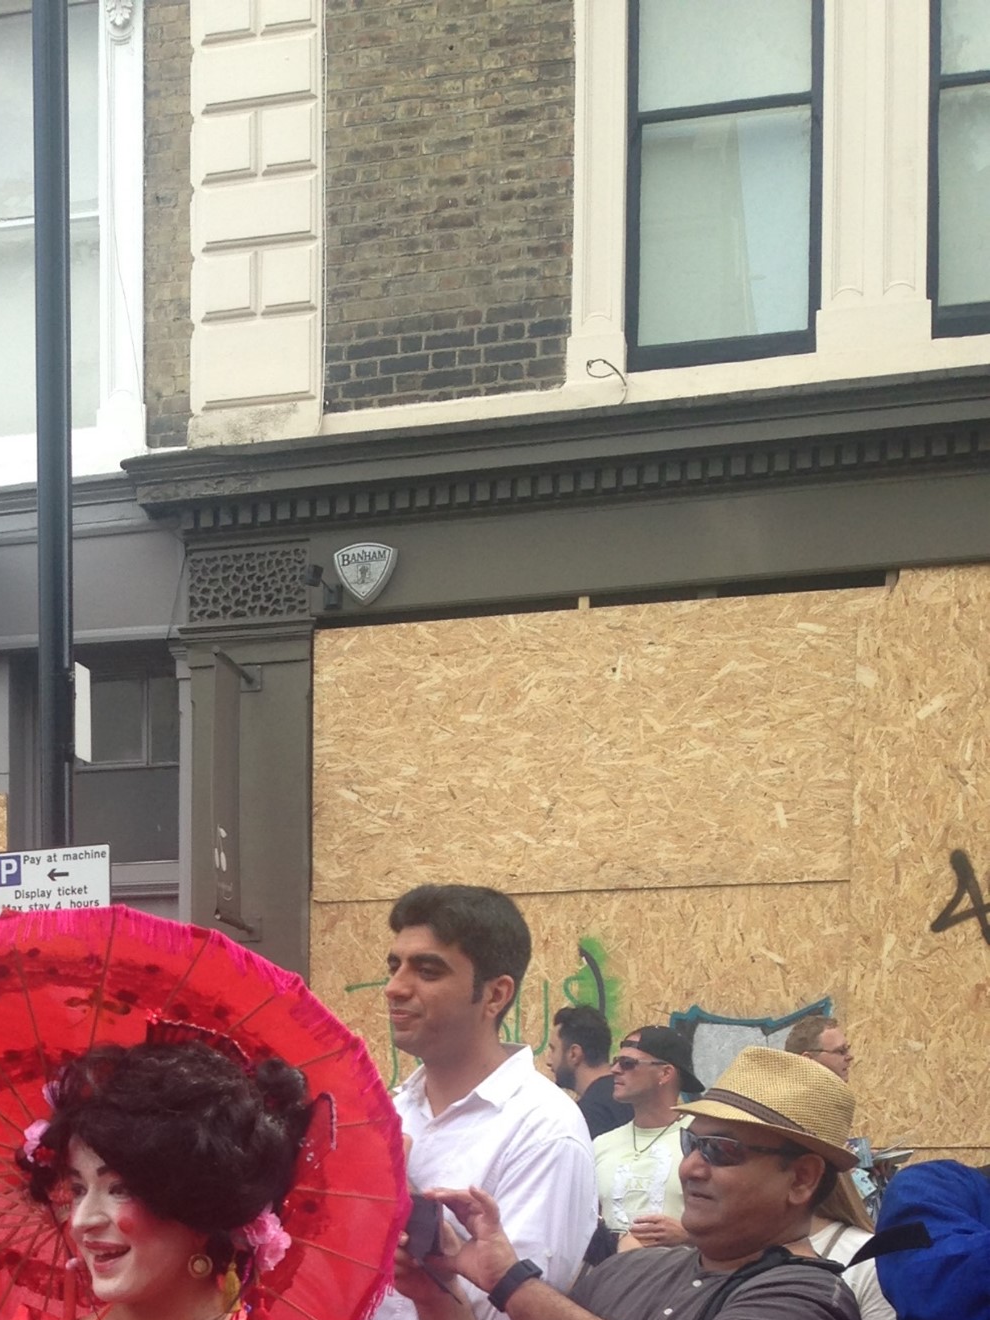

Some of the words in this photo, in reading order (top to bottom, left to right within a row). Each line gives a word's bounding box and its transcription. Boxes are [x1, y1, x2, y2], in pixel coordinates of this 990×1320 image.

[341, 549, 387, 567] BANHAM
[23, 855, 42, 866] Pay
[47, 852, 57, 863] at
[63, 849, 107, 861] machine
[14, 889, 52, 900] Display
[58, 885, 88, 897] ticket
[29, 902, 50, 911] stay
[70, 899, 100, 909] hours
